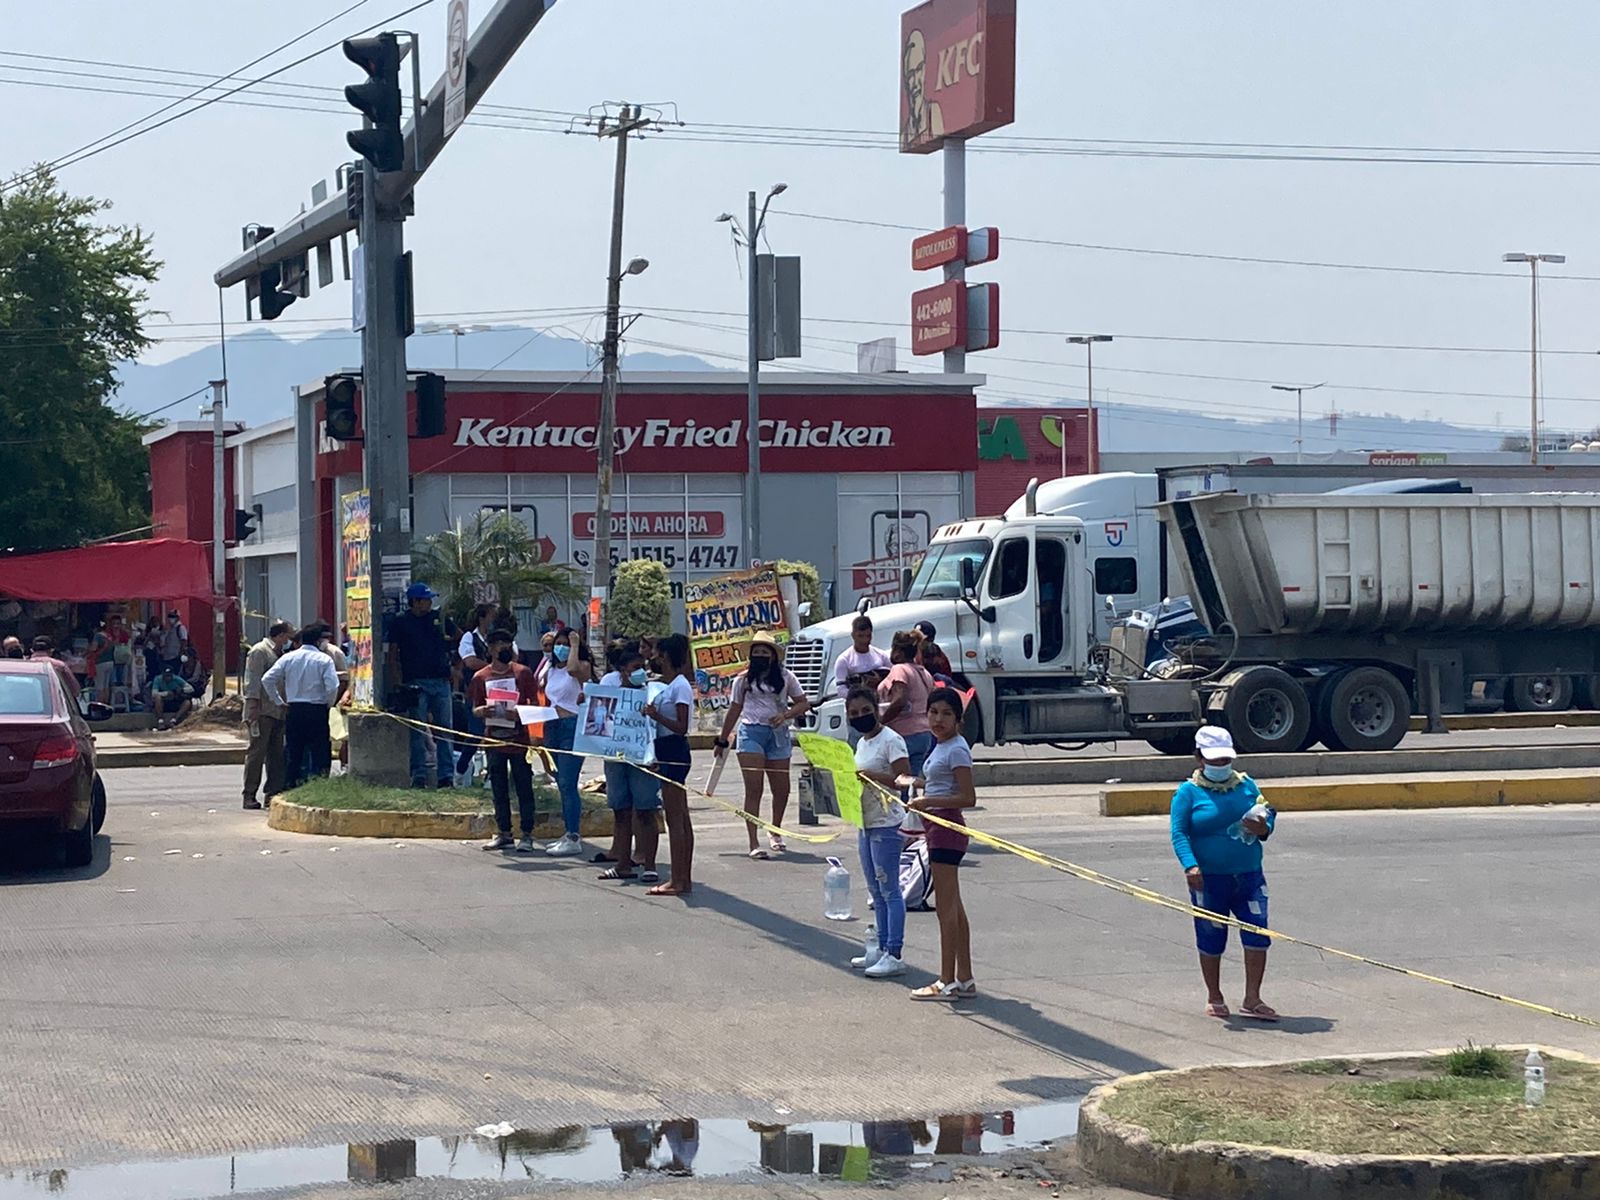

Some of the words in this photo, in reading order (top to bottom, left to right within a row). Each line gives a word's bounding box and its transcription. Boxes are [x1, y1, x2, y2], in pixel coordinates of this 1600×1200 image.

[935, 31, 984, 92] KFC
[916, 297, 952, 321] 442-6000
[642, 418, 742, 447] Fried
[746, 419, 893, 447] Chicken
[587, 516, 651, 533] ODENA
[654, 516, 709, 533] AHORA
[690, 599, 781, 636] MEXICANO
